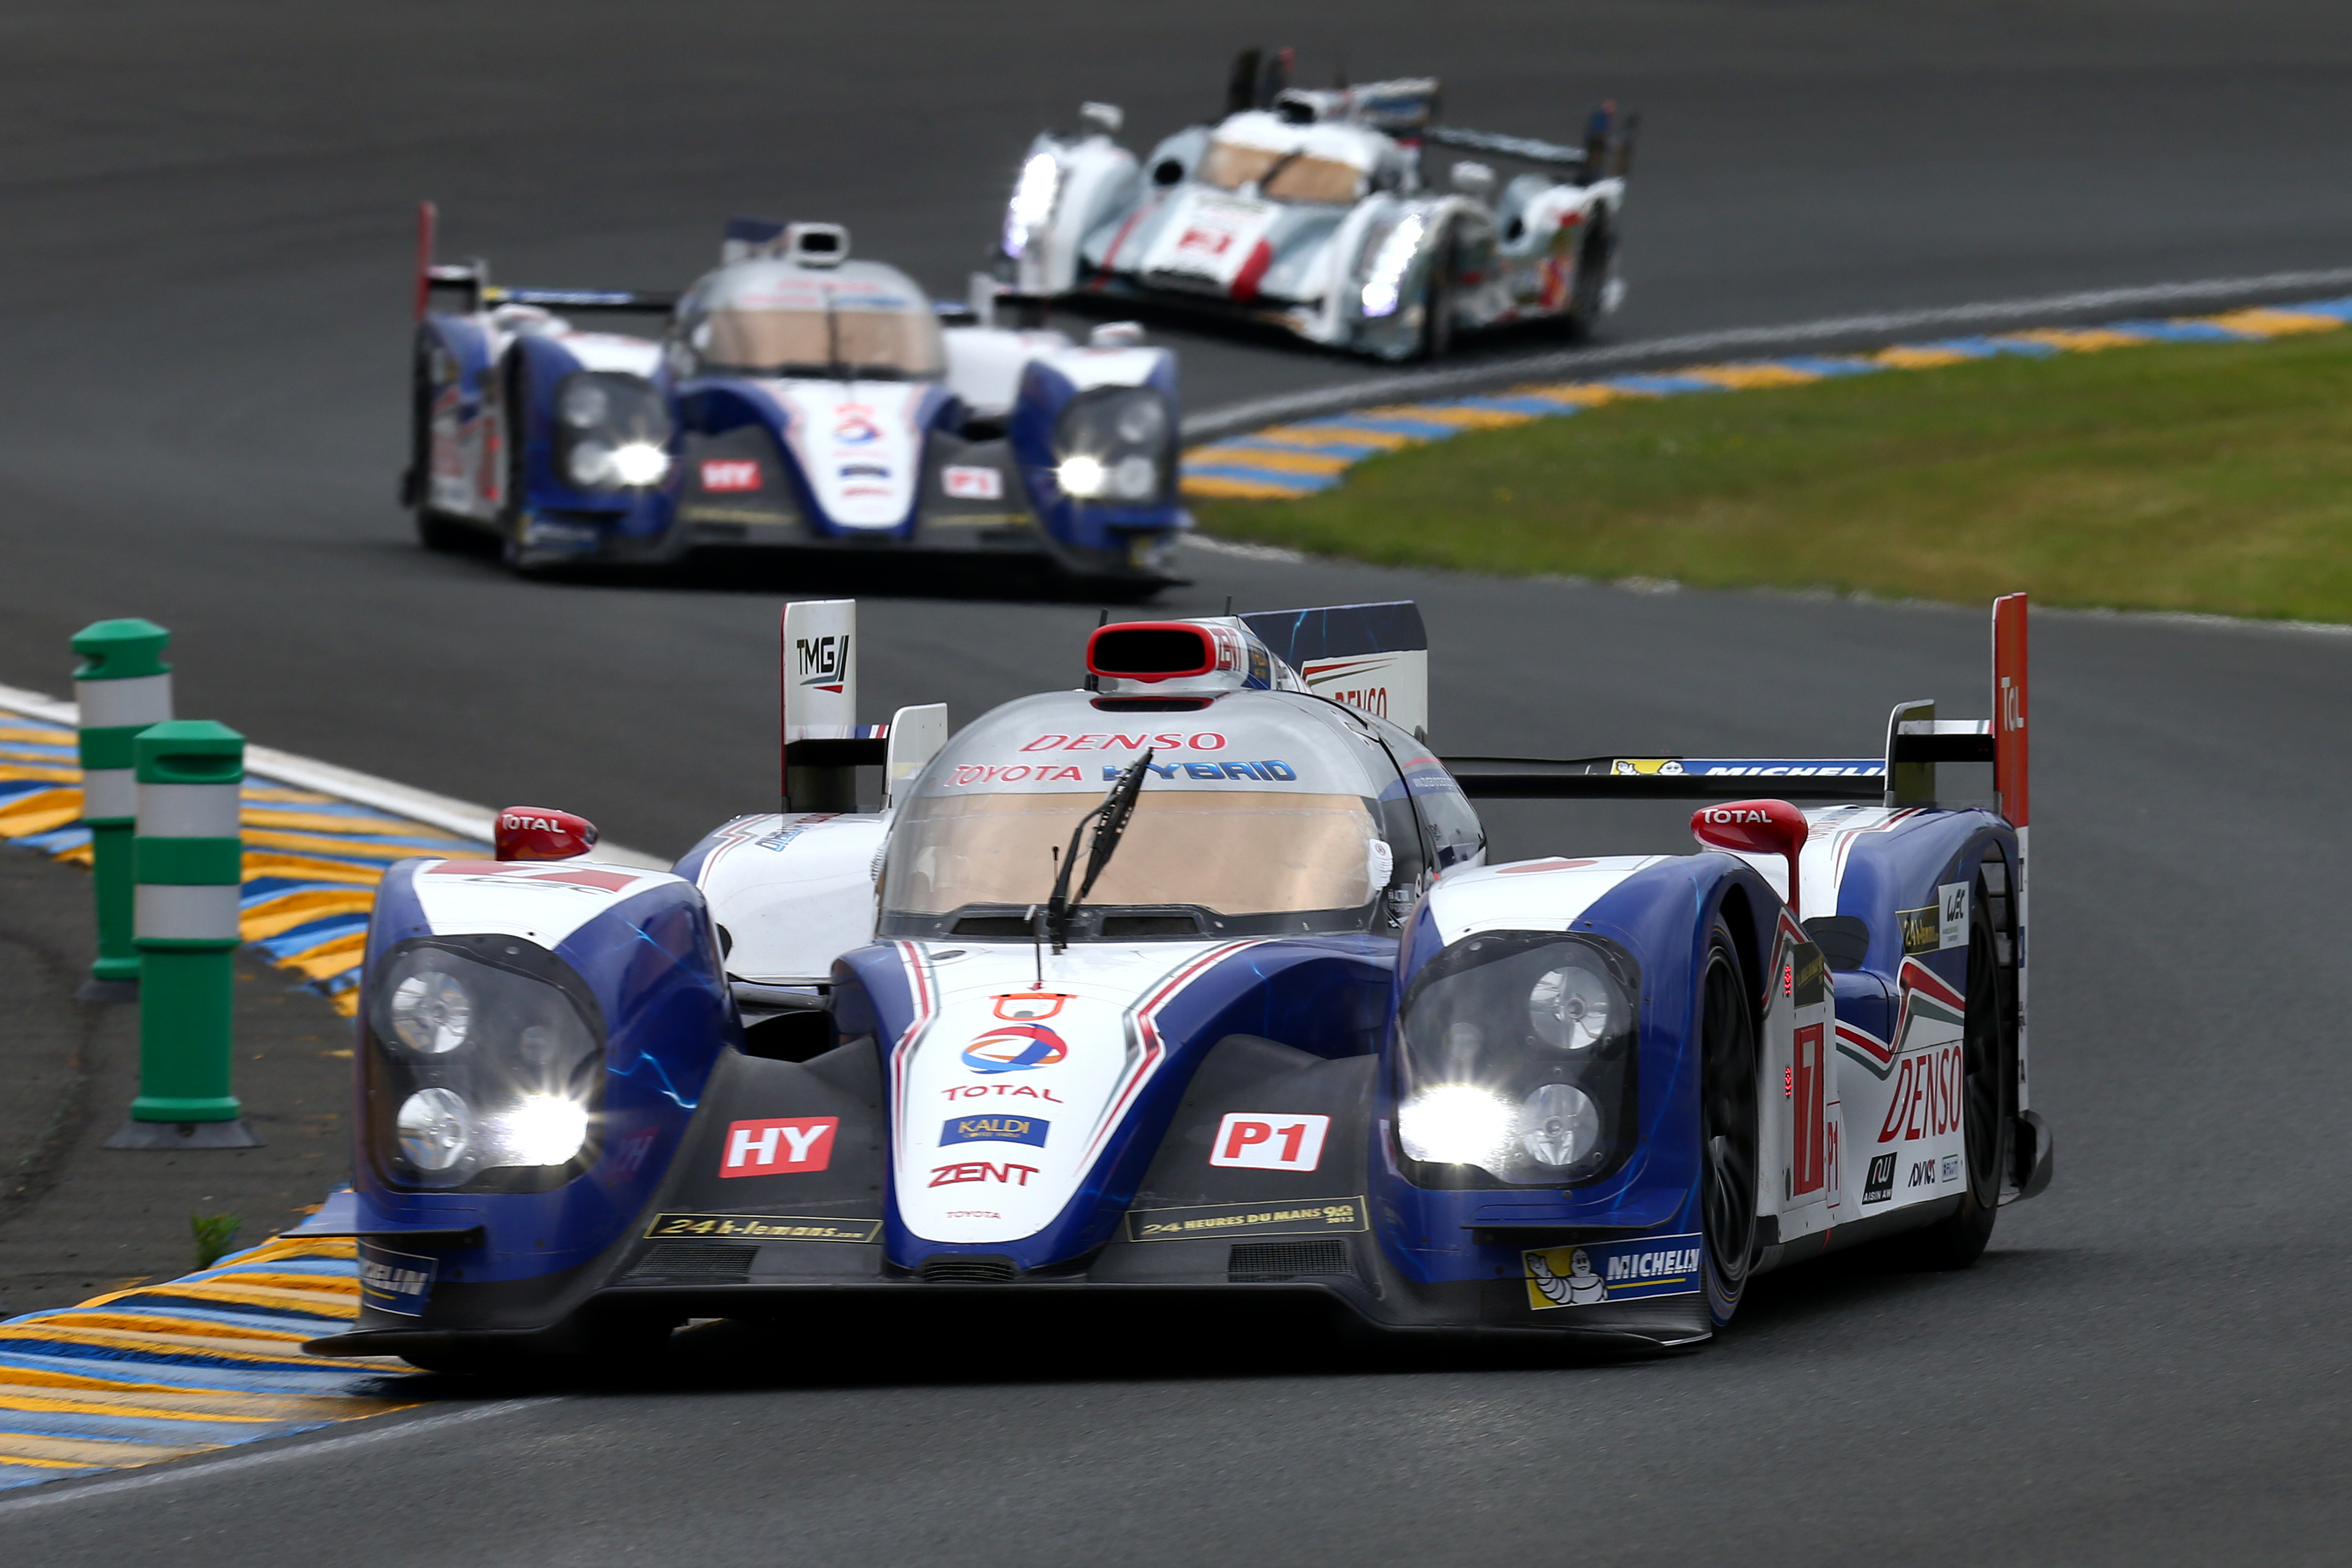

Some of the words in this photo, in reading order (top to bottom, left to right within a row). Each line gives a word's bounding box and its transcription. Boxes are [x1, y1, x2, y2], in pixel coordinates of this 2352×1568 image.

[797, 636, 834, 675] TMG
[1018, 733, 1227, 752] DENSO
[944, 764, 1084, 787] TOYOTA
[502, 814, 566, 833] TOTAL
[1702, 809, 1772, 823] TOTAL
[941, 1085, 1064, 1104] TOTAL
[1877, 1045, 1962, 1143] DENSO
[1803, 1039, 1815, 1182] 7
[958, 1119, 1030, 1133] KALDI
[727, 1125, 830, 1167] HY
[1224, 1121, 1308, 1161] P1
[1828, 1121, 1838, 1192] P1
[928, 1162, 1040, 1188] ZENT
[945, 1210, 1002, 1220] TOYOTA
[1140, 1223, 1183, 1235] 24
[1184, 1215, 1245, 1230] HEURES
[1246, 1212, 1271, 1223] DU
[1273, 1207, 1322, 1221] MANS
[1606, 1248, 1700, 1281] MICHELIN
